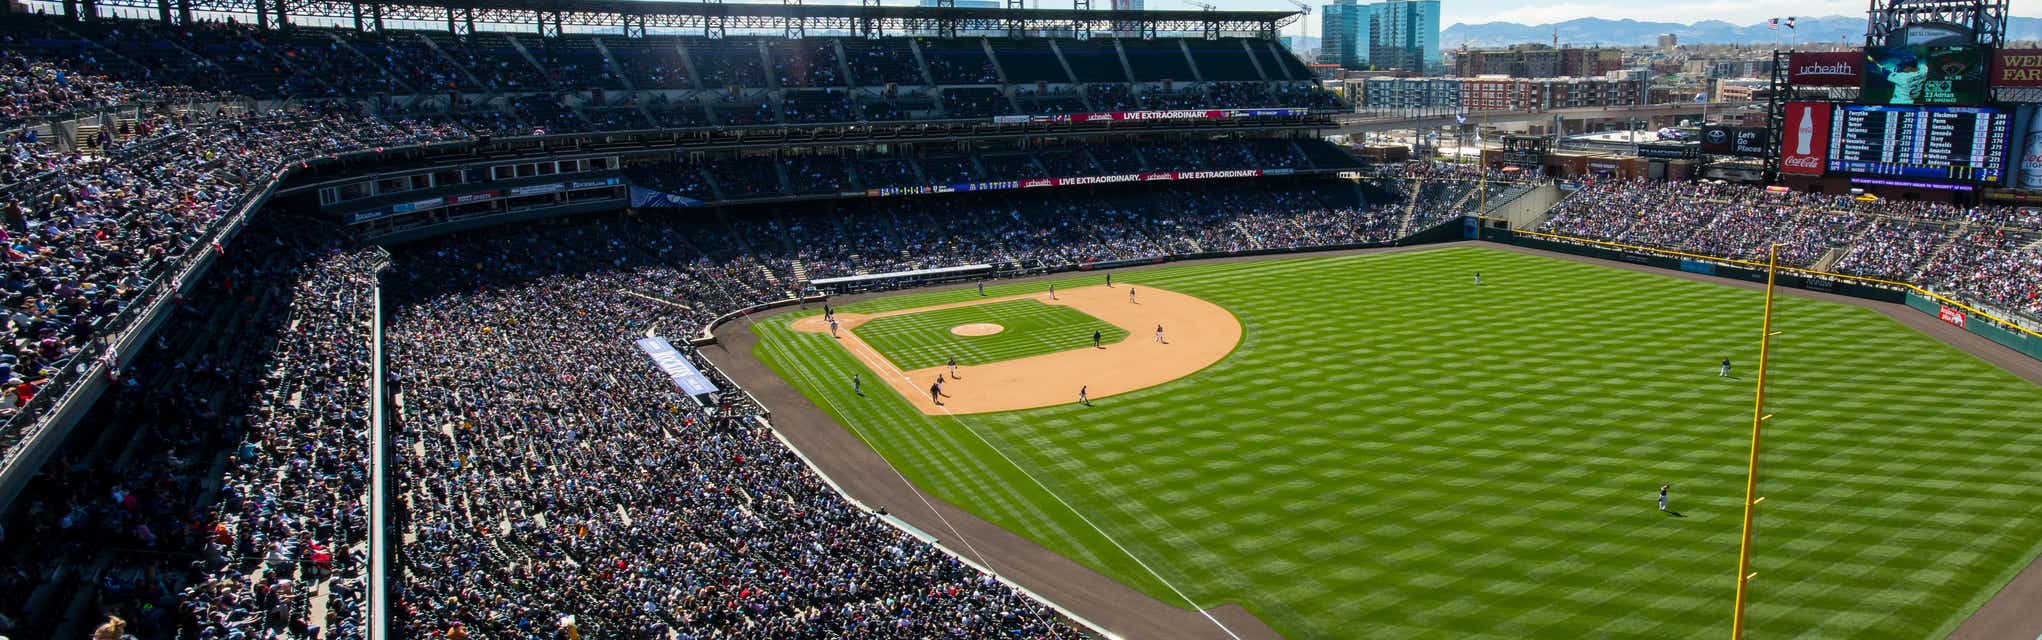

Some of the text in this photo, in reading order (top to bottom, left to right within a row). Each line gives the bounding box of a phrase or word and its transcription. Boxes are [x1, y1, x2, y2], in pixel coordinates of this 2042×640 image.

[1800, 61, 1852, 75] uchealth
[1142, 111, 1208, 119] EXTRAORDINARY.
[1077, 174, 1141, 184] EXTRAORDINARY.
[1195, 170, 1258, 179] EXTRAORDINARY.
